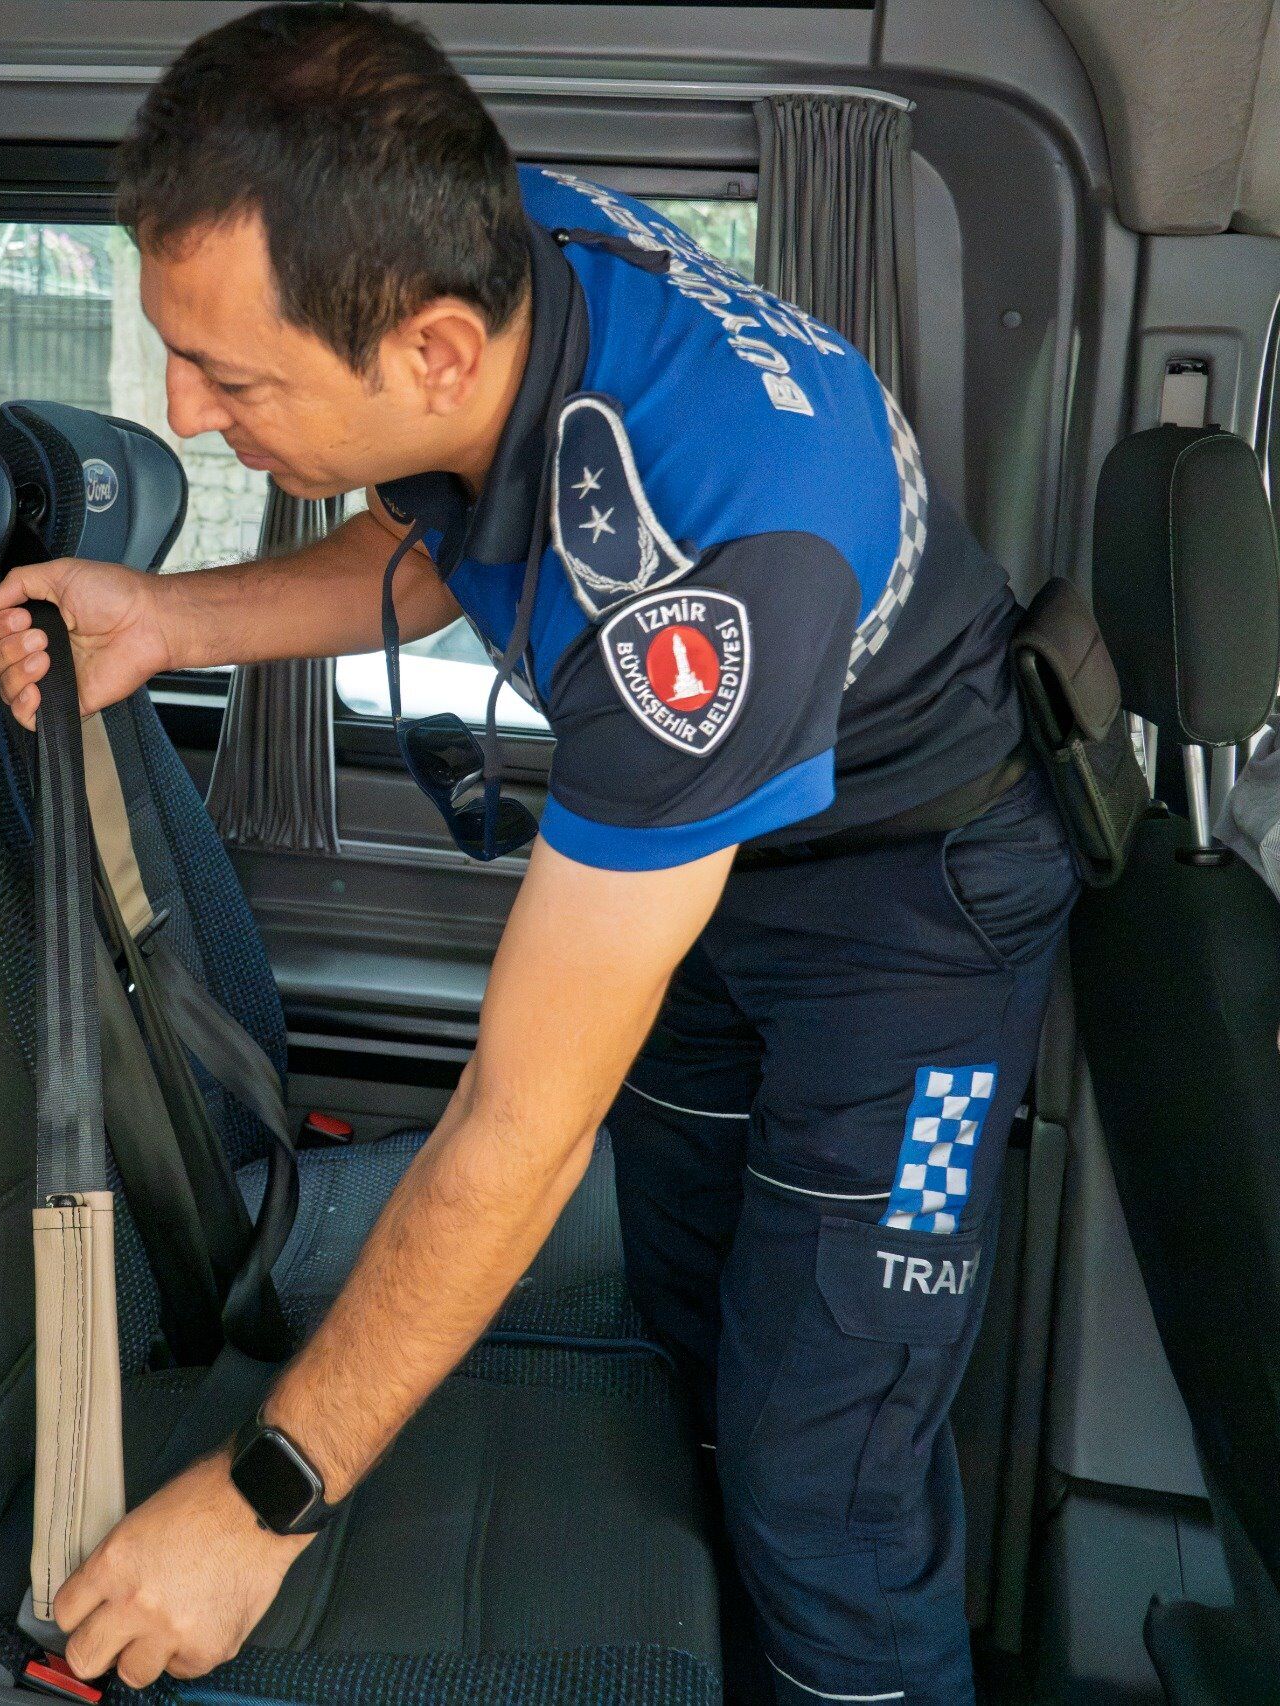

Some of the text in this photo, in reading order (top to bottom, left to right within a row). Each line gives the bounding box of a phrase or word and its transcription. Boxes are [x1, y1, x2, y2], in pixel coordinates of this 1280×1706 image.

[87, 467, 111, 501] Ford
[634, 598, 707, 634] İZMİR
[616, 642, 698, 742] BÜYÜKŞEHİR
[876, 1250, 981, 1295] TRAF
